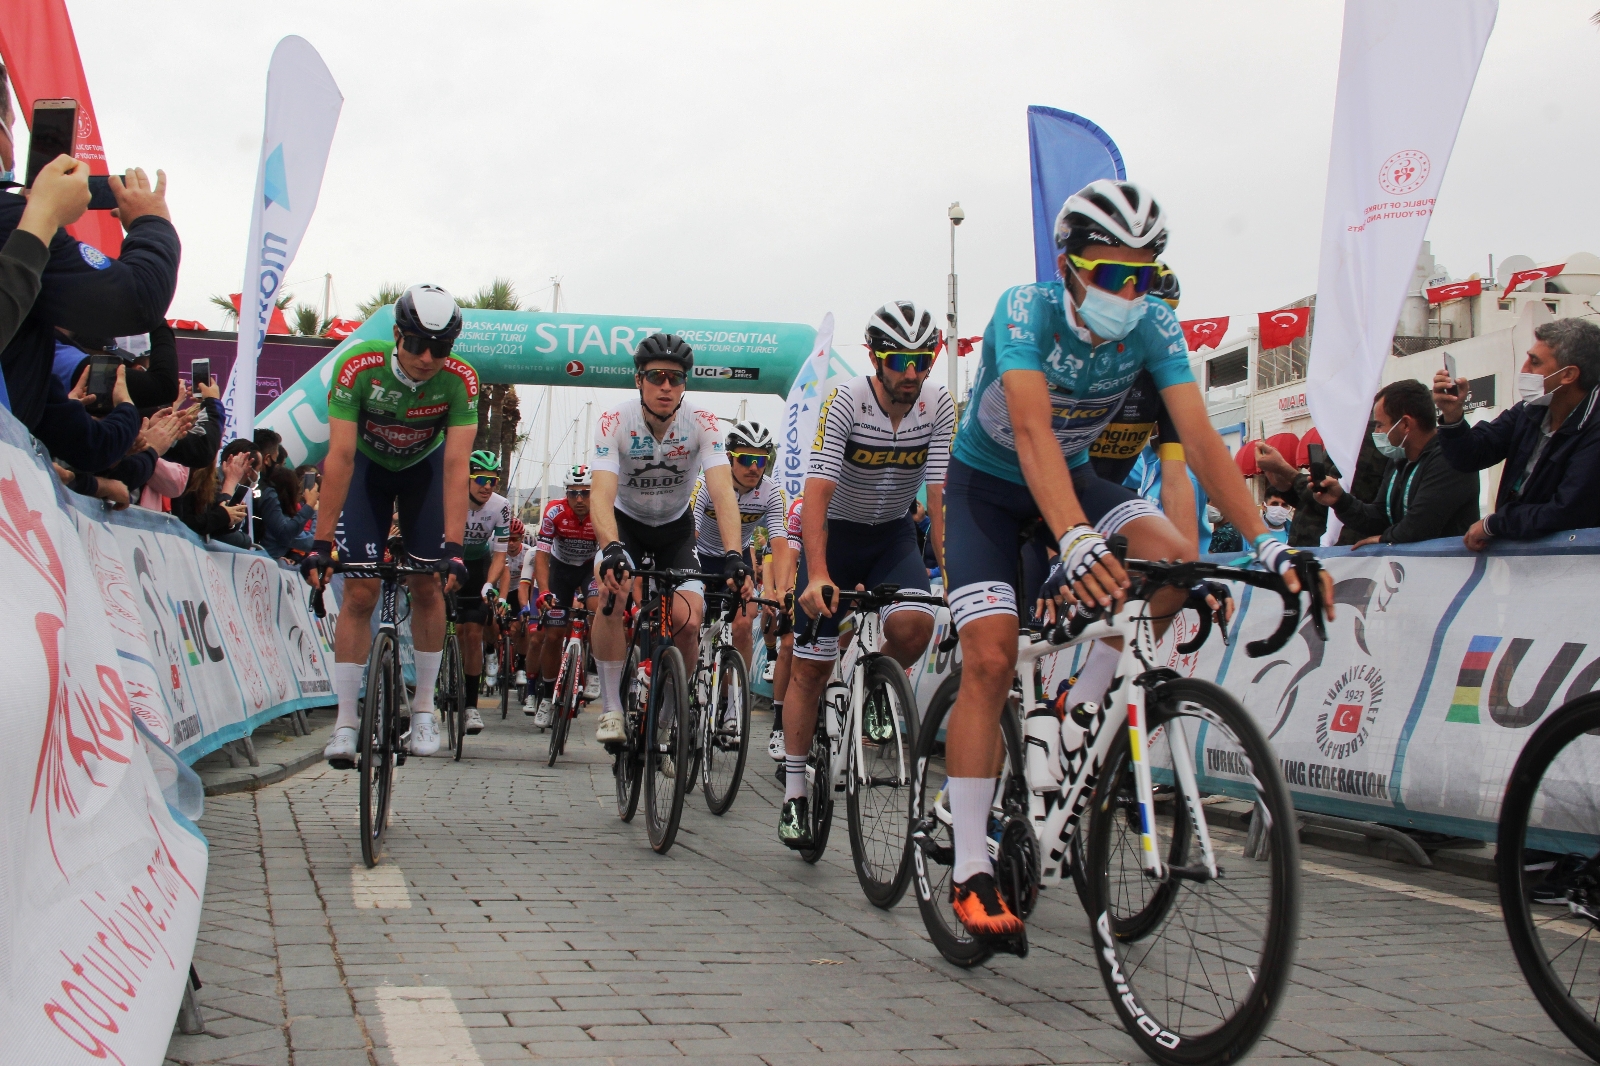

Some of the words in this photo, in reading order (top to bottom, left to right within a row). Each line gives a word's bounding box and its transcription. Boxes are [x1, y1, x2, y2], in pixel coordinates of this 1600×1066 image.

[501, 332, 526, 343] TURU
[676, 330, 778, 344] PRESIDENTIAL
[708, 344, 731, 352] TOUR
[732, 345, 745, 353] OF
[746, 346, 778, 354] TURKEY
[340, 355, 384, 387] SALCANO
[589, 365, 635, 375] TURKISH
[694, 367, 717, 377] UCI
[371, 425, 427, 441] Alpecin
[851, 448, 928, 466] DELKO
[627, 475, 684, 488] ABLOC
[1322, 664, 1368, 707] TÜRKİYE
[1344, 690, 1365, 702] 1923
[1315, 713, 1370, 760] FEDERASYONU
[1308, 763, 1388, 800] FEDERATION
[1097, 910, 1181, 1050] CORIMA
